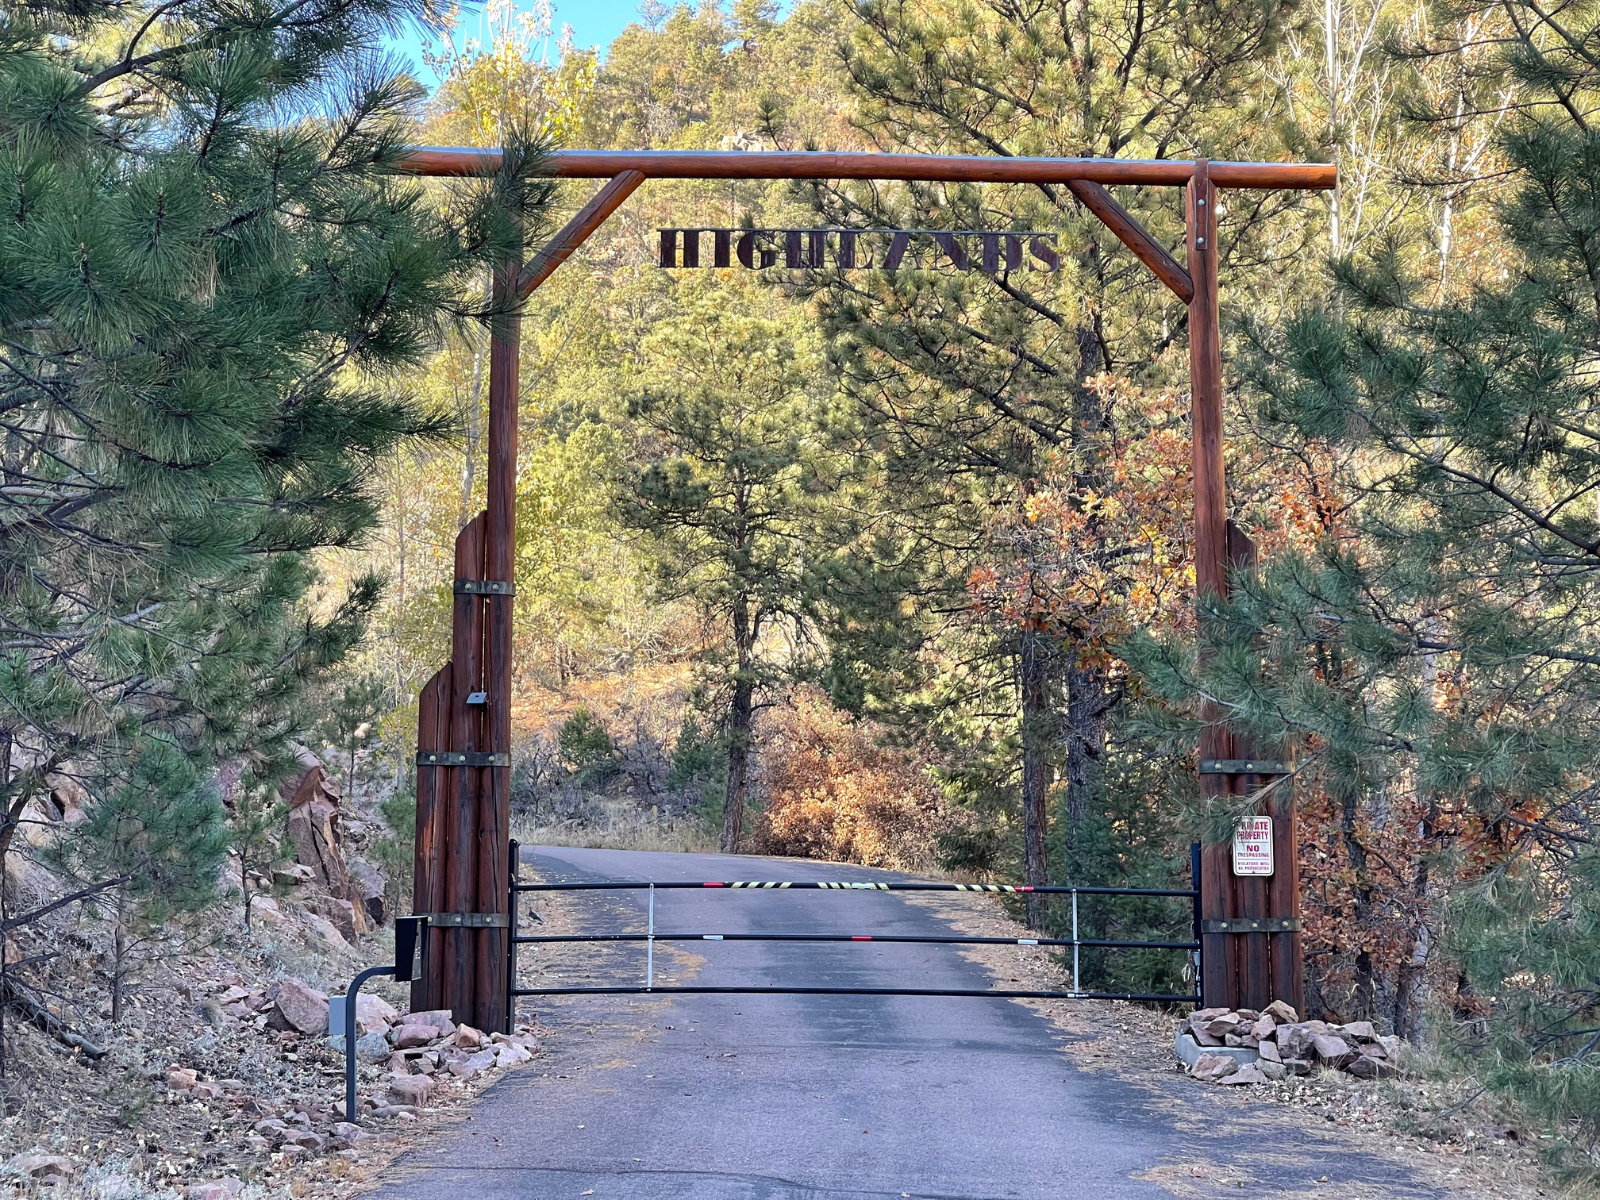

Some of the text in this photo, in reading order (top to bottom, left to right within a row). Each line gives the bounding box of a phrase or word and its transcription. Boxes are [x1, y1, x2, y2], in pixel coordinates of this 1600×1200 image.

[656, 229, 1060, 272] HIGHLANDS
[1236, 822, 1268, 830] RIVATE
[1236, 831, 1268, 840] PROPERTY
